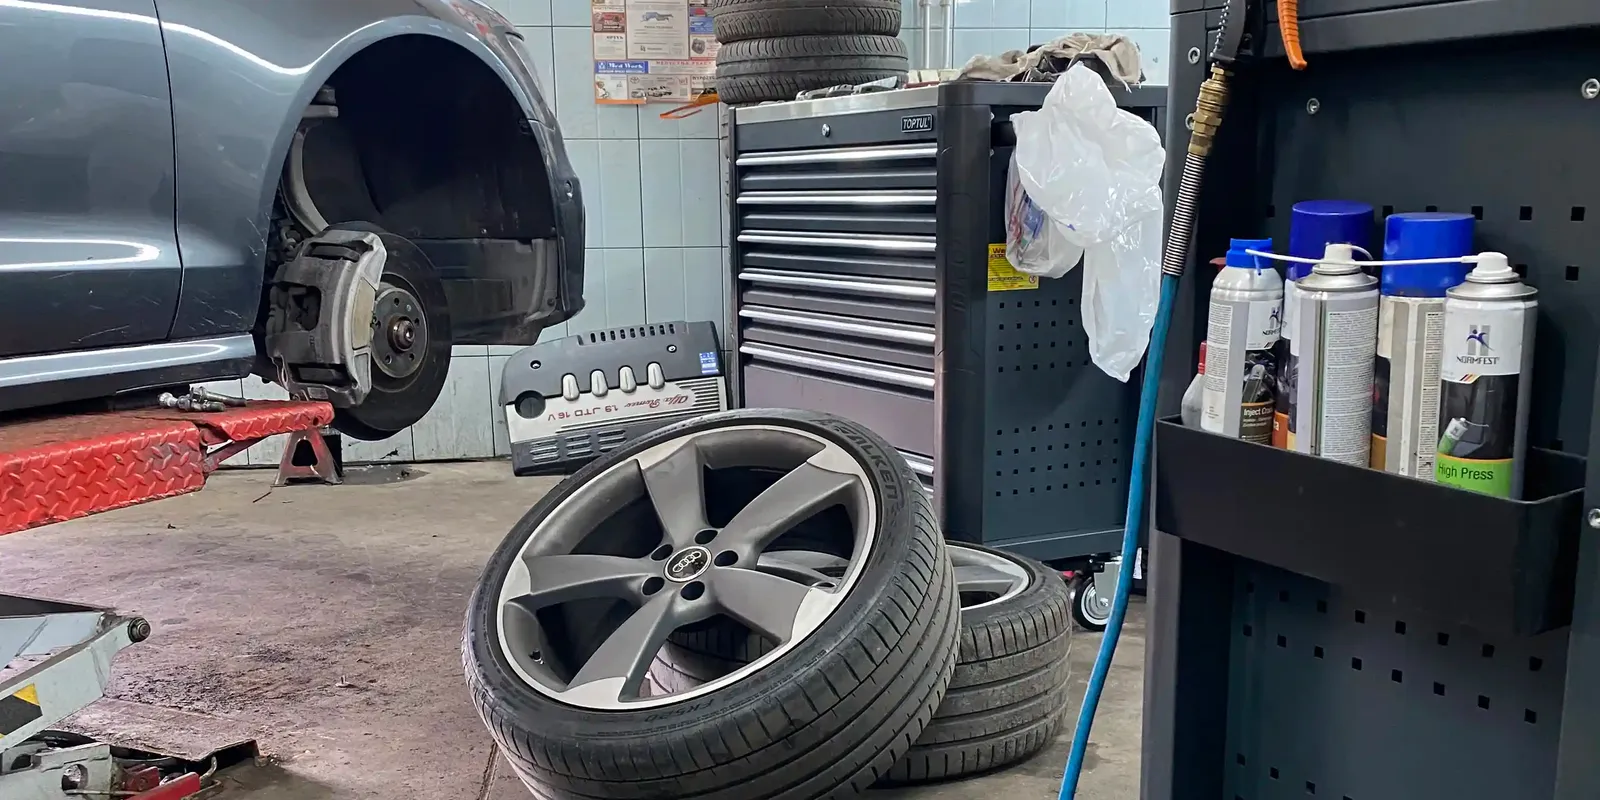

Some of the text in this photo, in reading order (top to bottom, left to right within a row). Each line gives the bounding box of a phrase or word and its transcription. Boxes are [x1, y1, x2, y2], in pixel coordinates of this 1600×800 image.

[903, 117, 928, 129] TOPTUL
[1456, 355, 1499, 365] NORMFEST
[624, 400, 660, 409] Romeo
[665, 395, 689, 405] Alfa
[574, 407, 601, 417] JTD
[605, 404, 619, 412] 1.9
[1243, 408, 1261, 417] Inject
[1438, 463, 1494, 480] High Press
